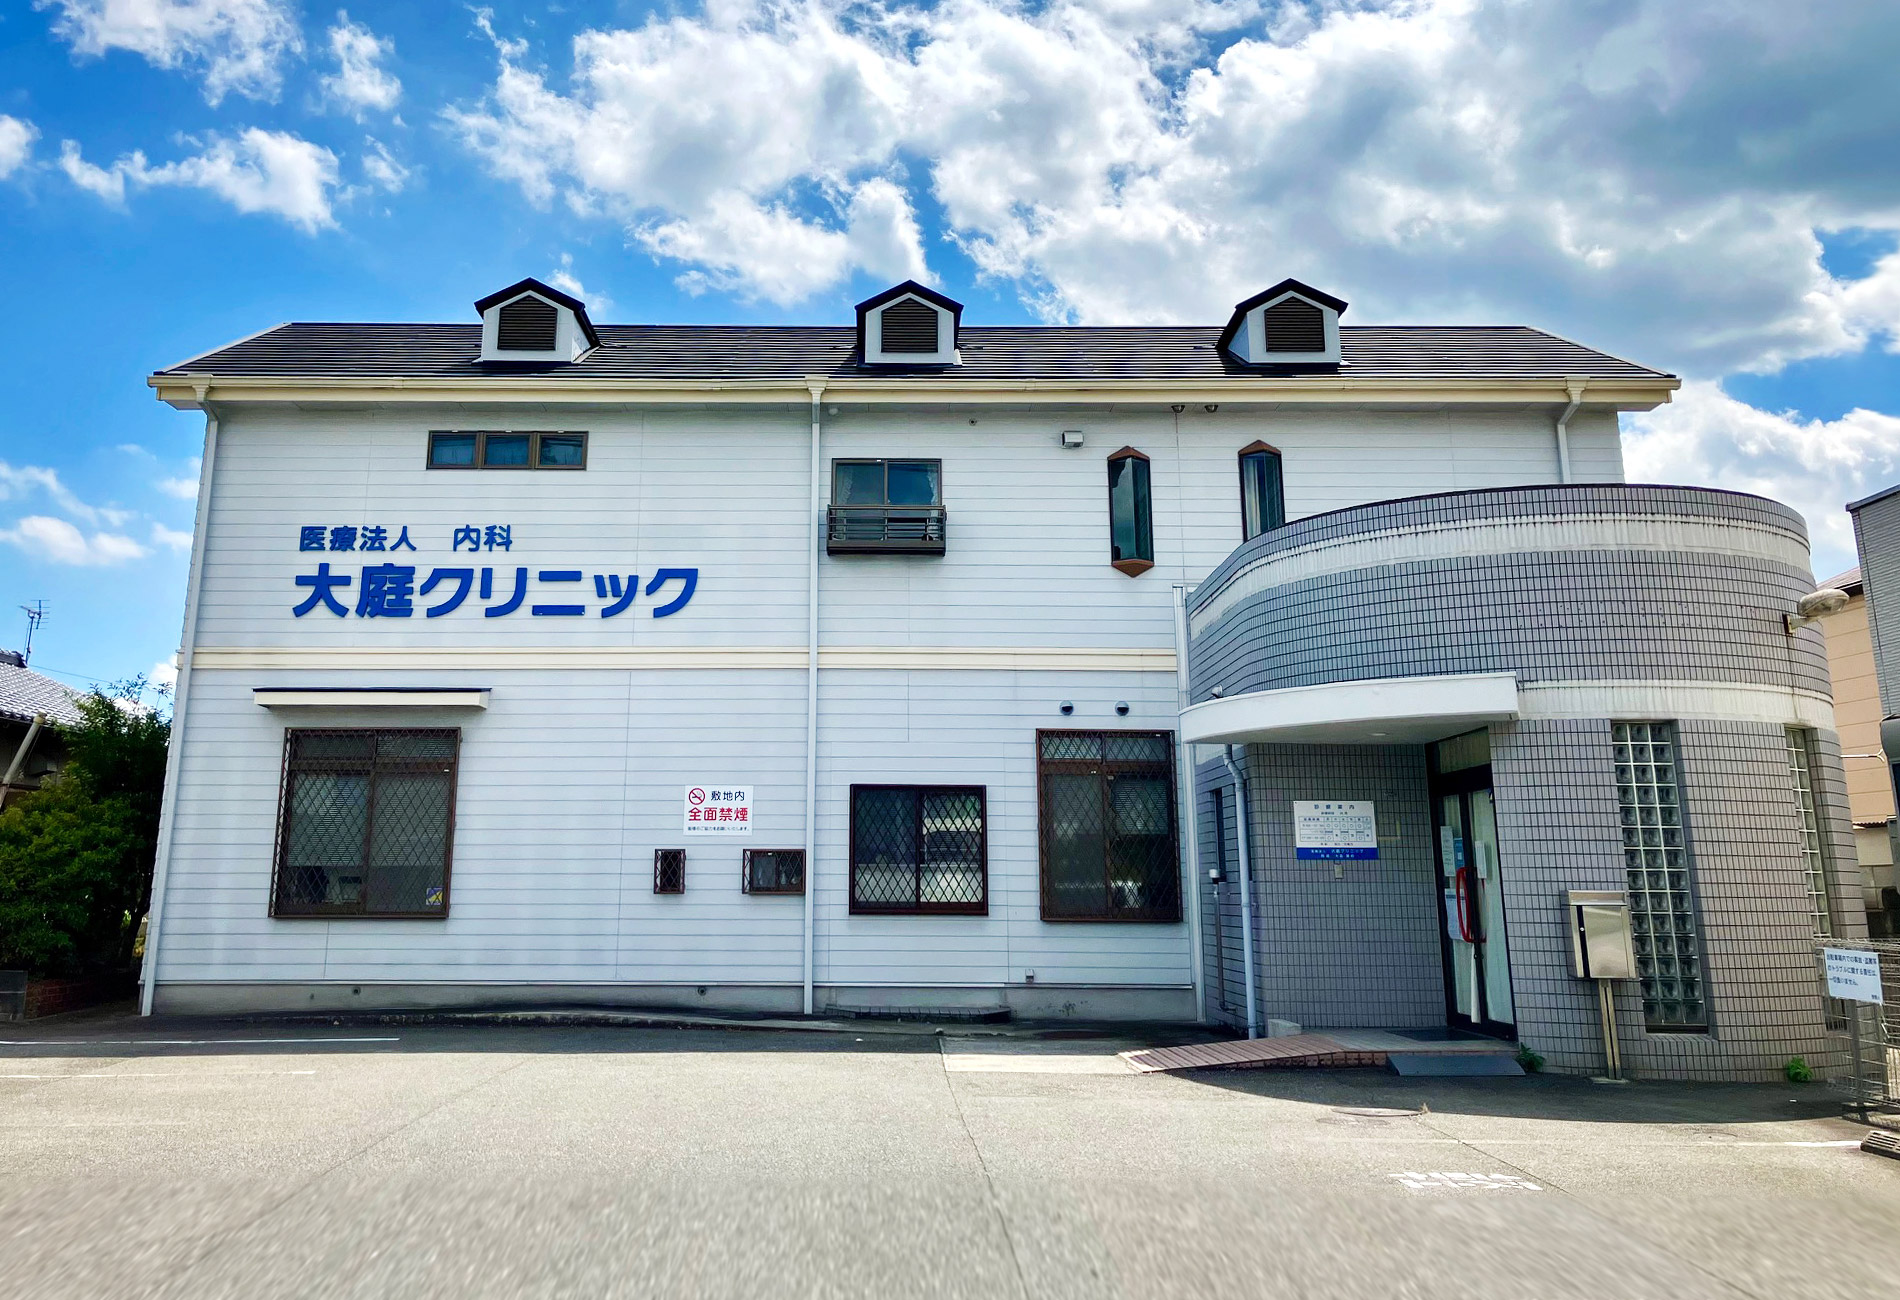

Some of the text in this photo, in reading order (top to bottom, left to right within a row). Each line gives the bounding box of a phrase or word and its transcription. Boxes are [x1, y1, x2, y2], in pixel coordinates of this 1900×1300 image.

[299, 524, 513, 552] 医療法人 内科
[292, 562, 699, 618] 大庭クリニック
[710, 790, 745, 801] 敷地内
[688, 807, 748, 822] 全面禁煙
